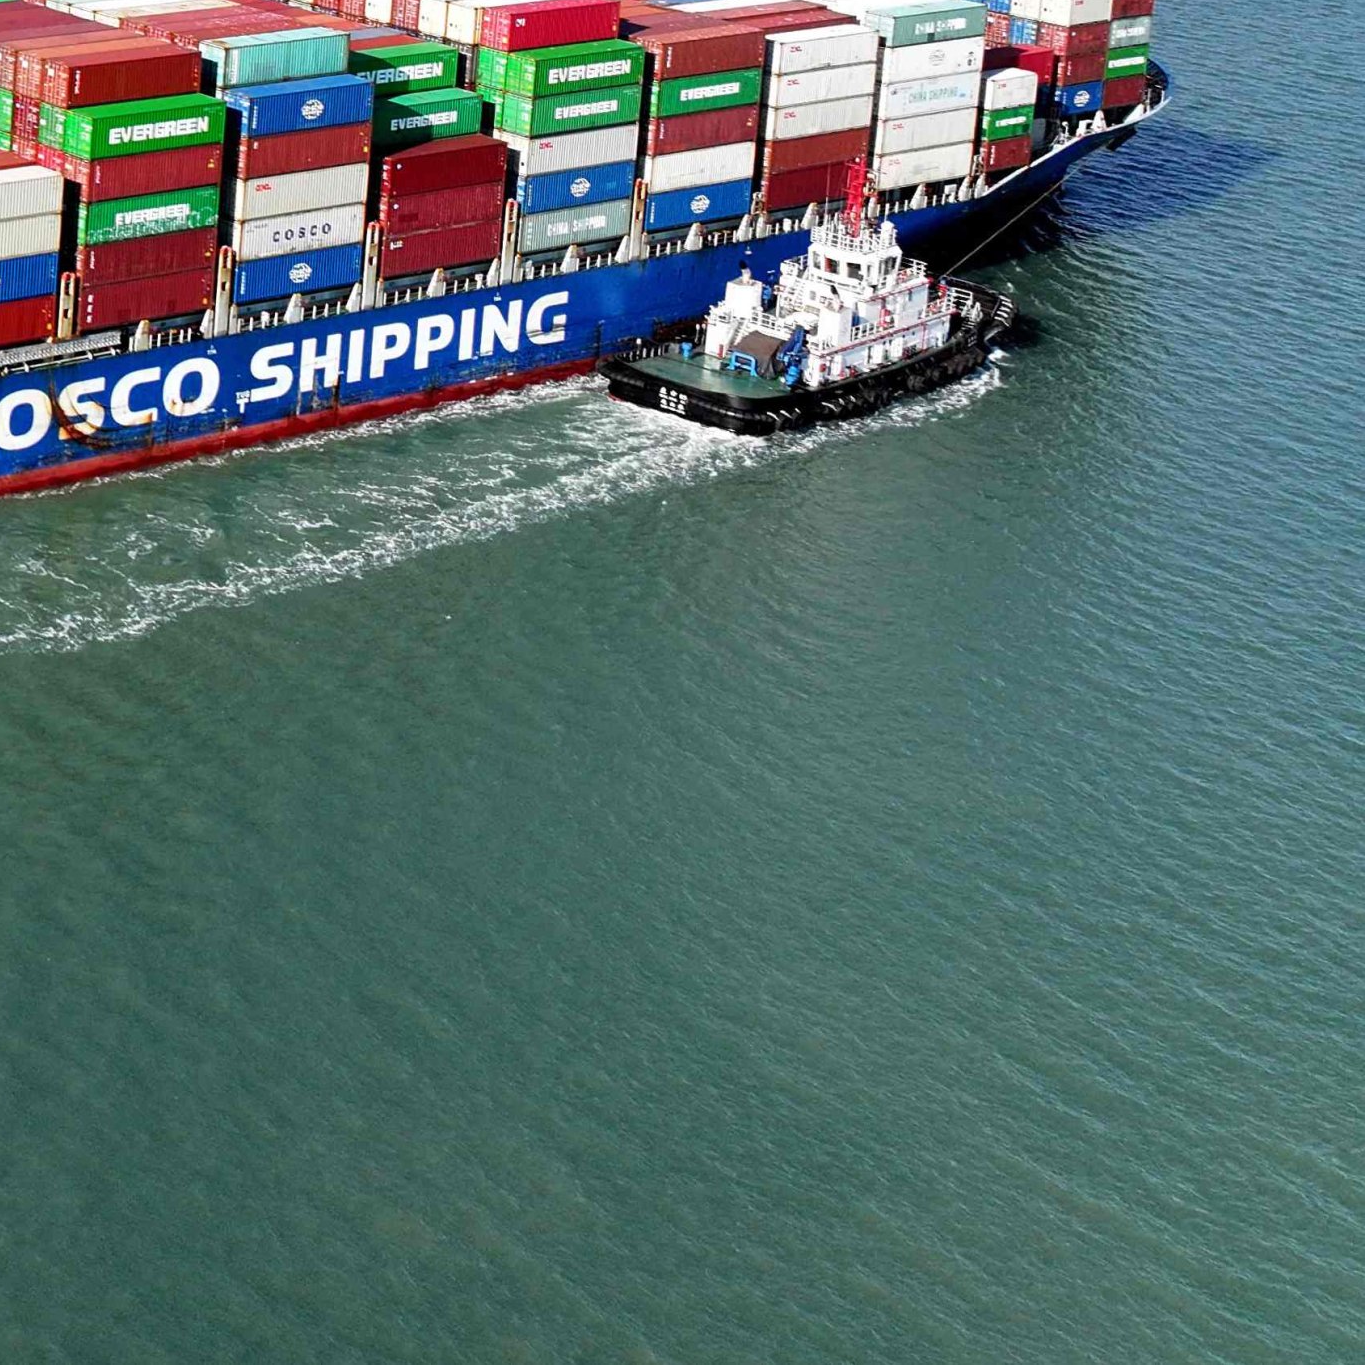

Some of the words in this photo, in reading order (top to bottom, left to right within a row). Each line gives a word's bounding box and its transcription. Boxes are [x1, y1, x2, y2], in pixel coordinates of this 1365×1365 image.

[548, 59, 632, 85] EVERGREEN
[390, 110, 458, 131] EVERGREEN
[554, 99, 618, 120] EVERGREEN
[108, 115, 210, 145] EVERGREEN
[272, 222, 332, 243] COSCO
[249, 290, 570, 403] SHIPPING
